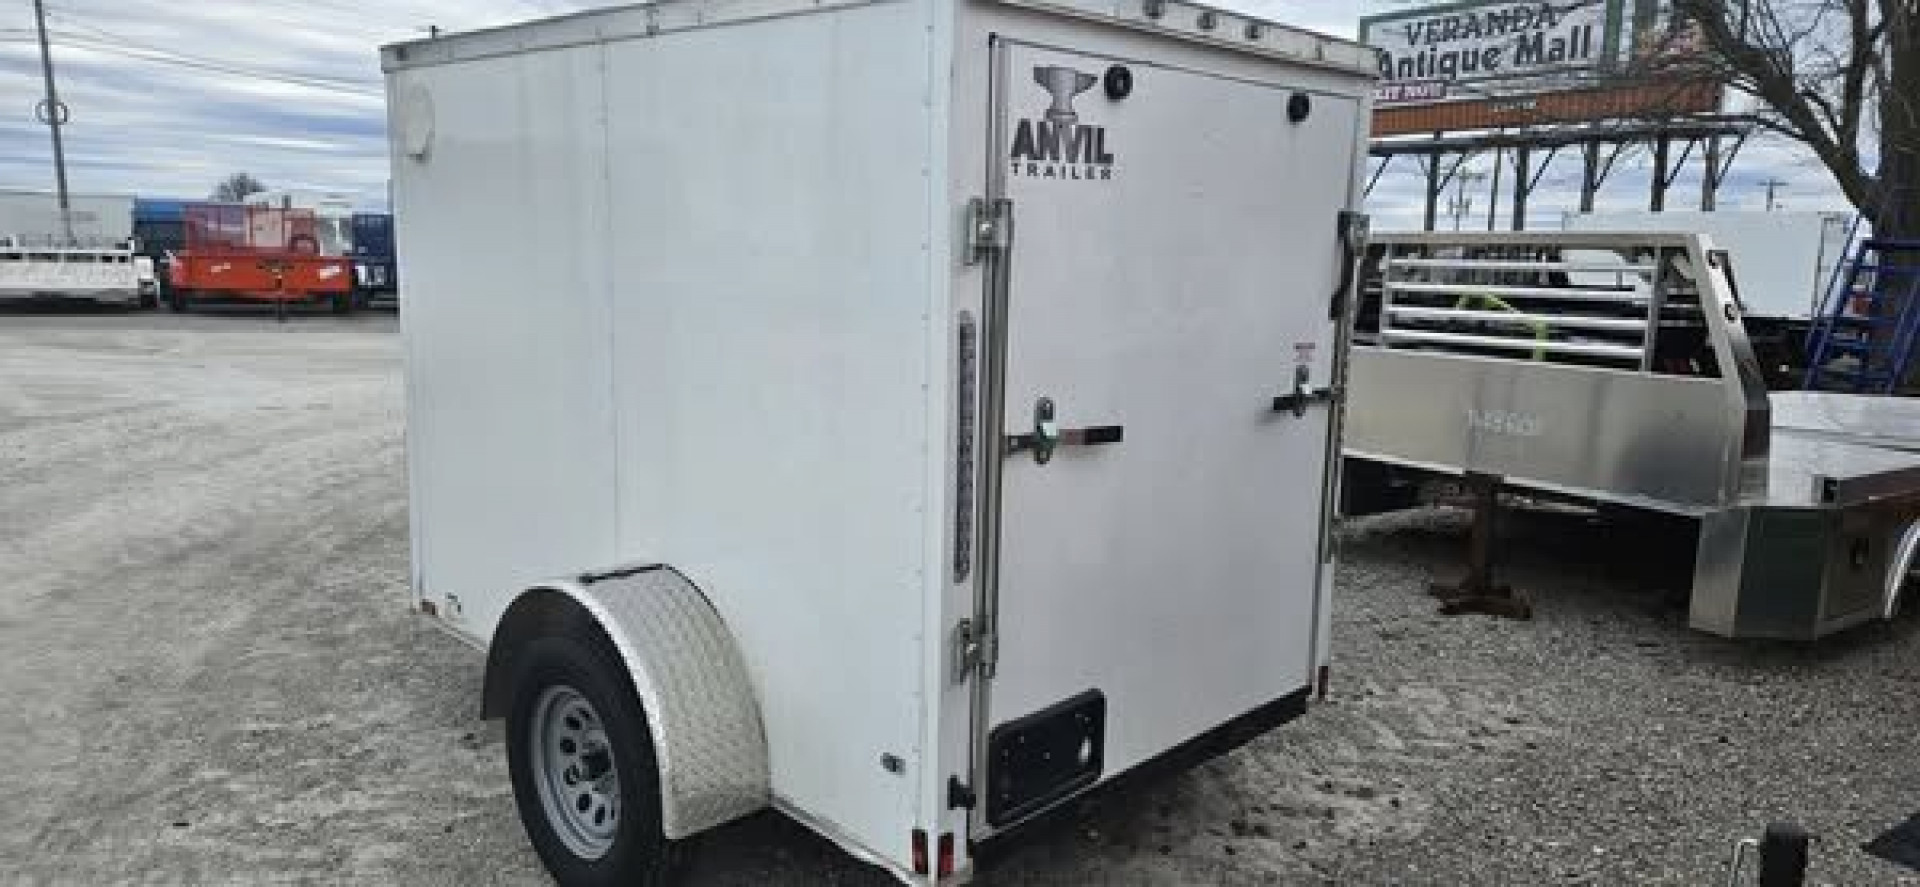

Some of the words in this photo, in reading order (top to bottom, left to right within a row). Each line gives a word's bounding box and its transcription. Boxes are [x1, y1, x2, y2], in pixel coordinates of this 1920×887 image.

[1405, 3, 1560, 46] VERANDA
[1376, 46, 1501, 83] Antique
[1514, 25, 1592, 66] Mall
[1010, 118, 1114, 163] ANVIL
[1010, 162, 1113, 180] TRAILER
